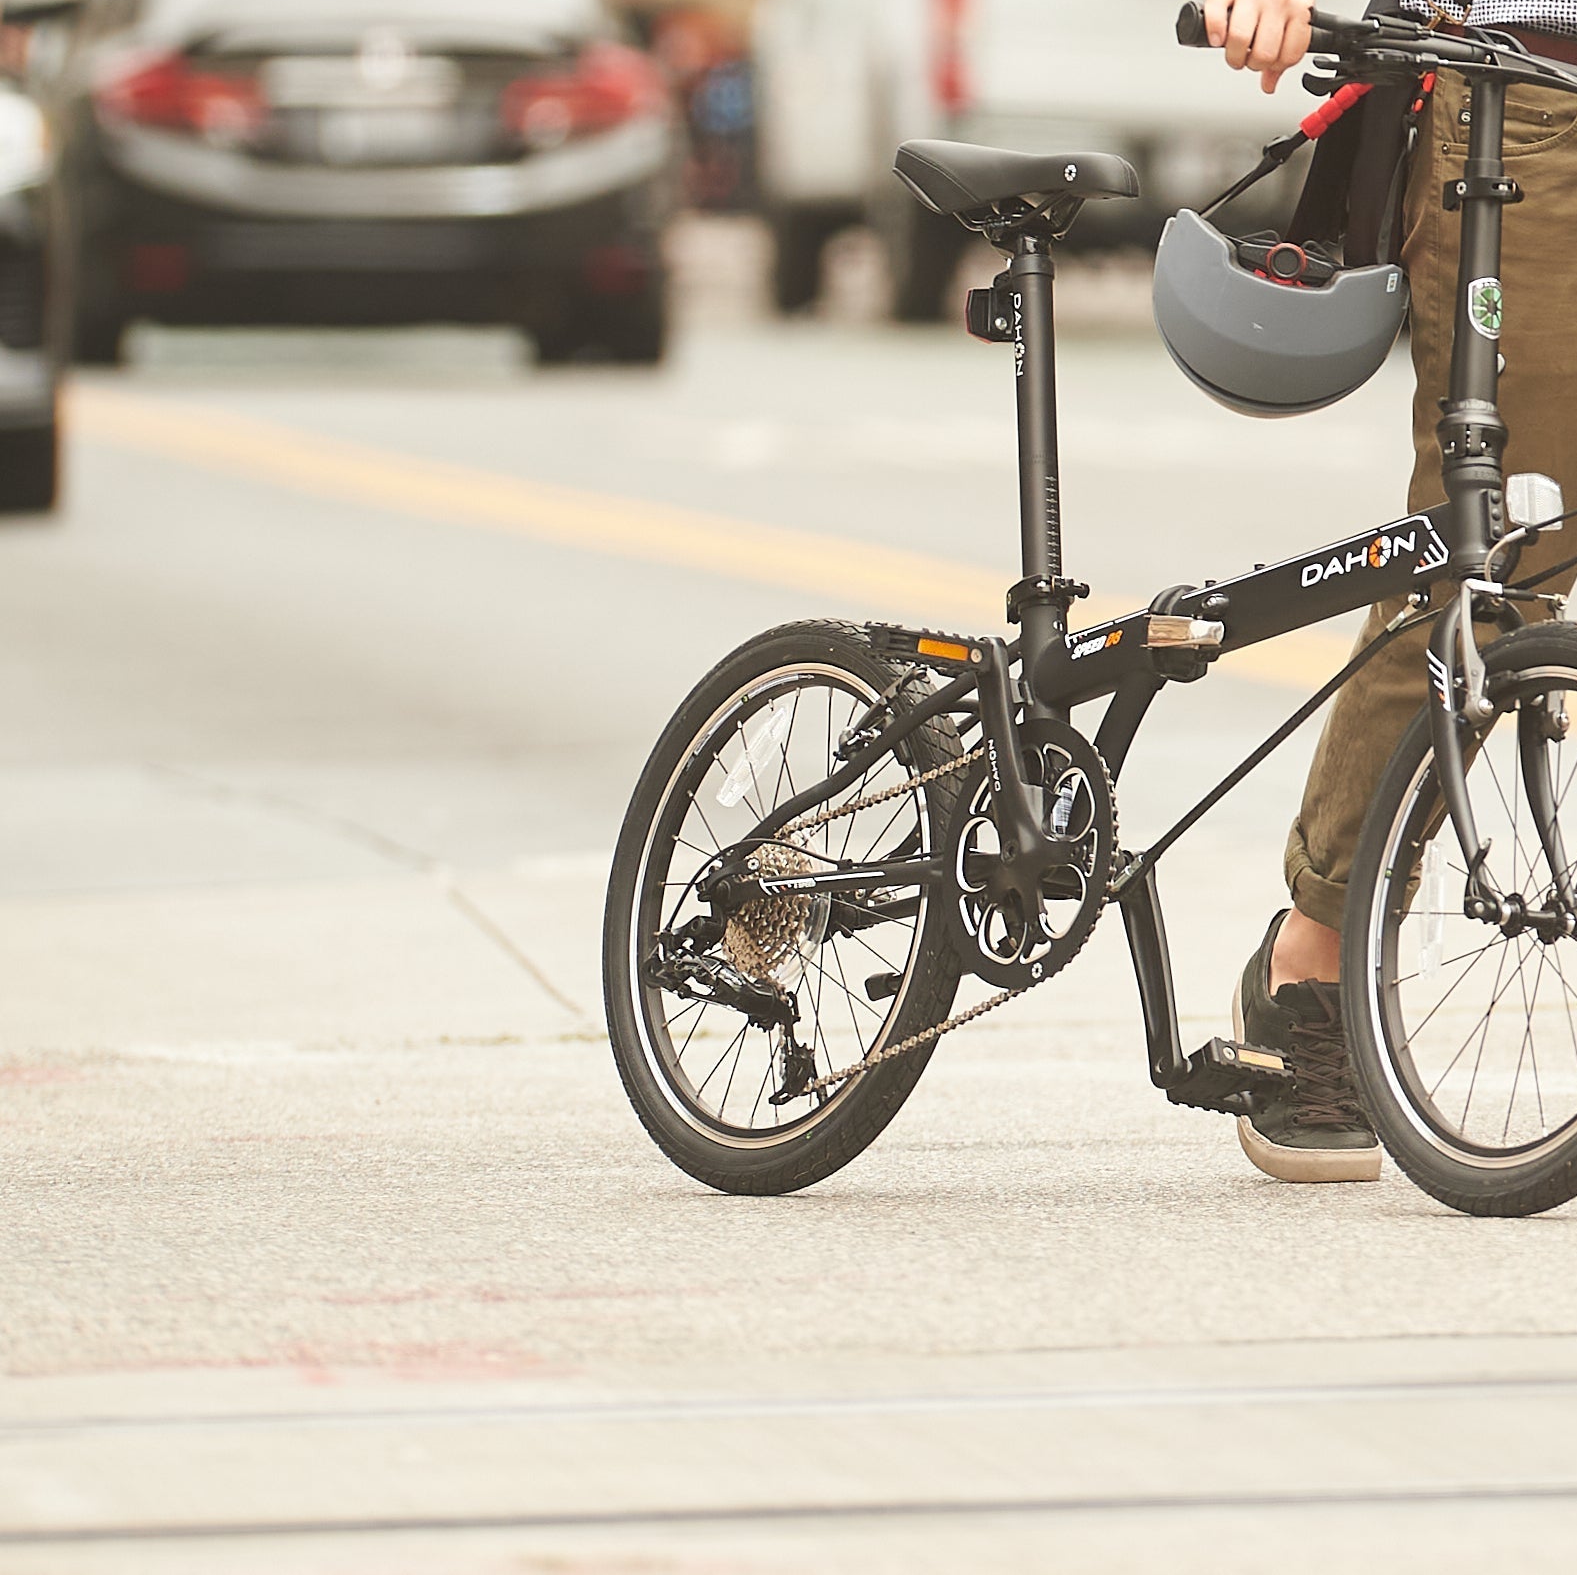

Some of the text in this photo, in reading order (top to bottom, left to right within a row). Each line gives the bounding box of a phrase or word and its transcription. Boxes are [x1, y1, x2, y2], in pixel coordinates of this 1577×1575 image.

[1013, 292, 1026, 377] DAHON
[1301, 530, 1417, 588] DAHON
[987, 738, 1001, 792] DAHON
